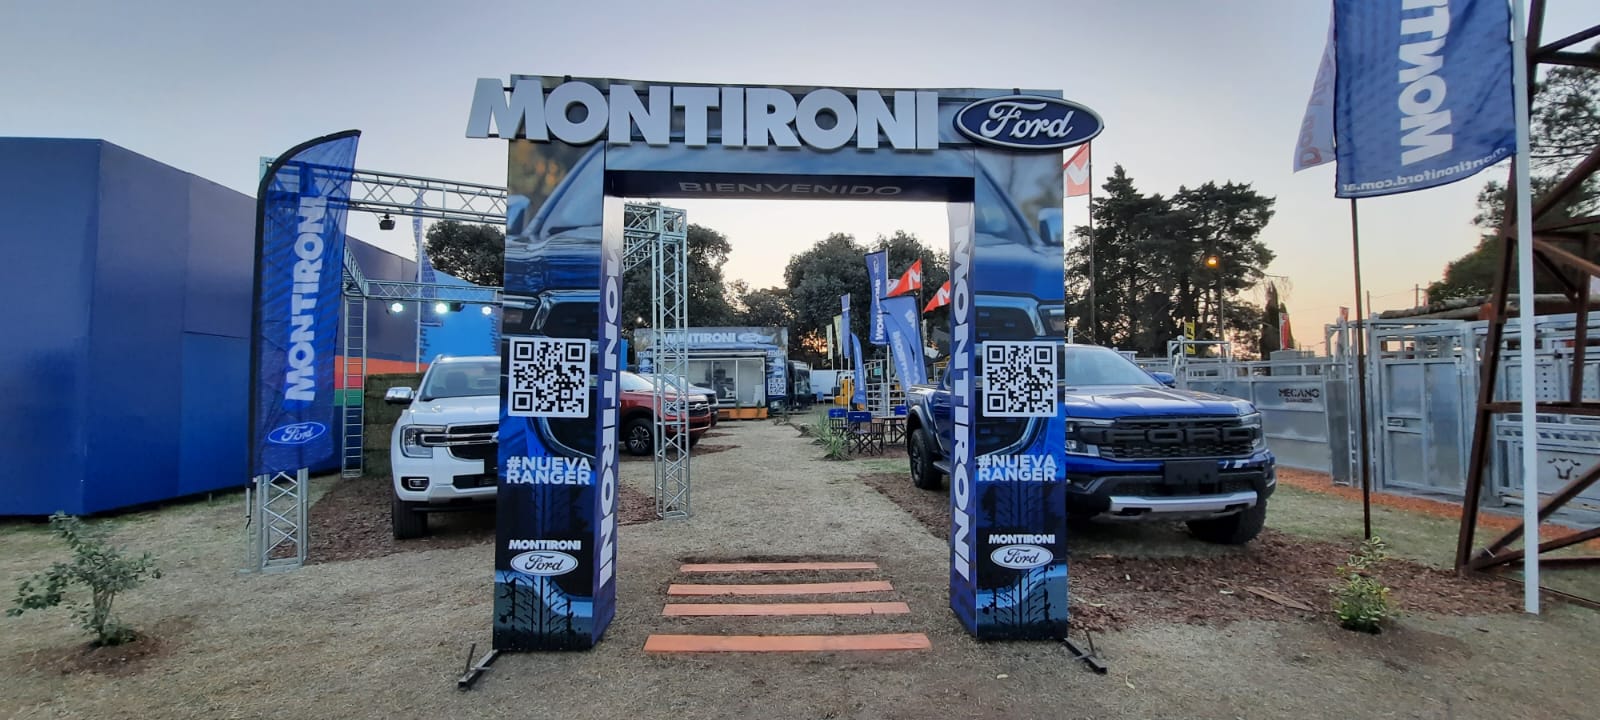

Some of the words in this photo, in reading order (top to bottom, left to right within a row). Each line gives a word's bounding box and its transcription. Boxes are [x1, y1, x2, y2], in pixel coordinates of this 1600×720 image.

[465, 77, 939, 152] MONTIRONI
[979, 101, 1075, 138] Ford
[679, 181, 902, 197] BIENVENIDO
[285, 195, 327, 402] MONTIRONI
[599, 228, 621, 589] MONTIRONI
[951, 225, 971, 583] MONTIRONI
[506, 456, 592, 471] #NUEVA
[977, 454, 1057, 468] #NUEVA
[506, 469, 591, 485] RANGER
[977, 467, 1057, 482] RANGER
[508, 539, 581, 551] MONTIRONI
[988, 534, 1056, 545] MONTIRONI
[524, 554, 564, 572] Ford
[1002, 548, 1040, 564] Ford
